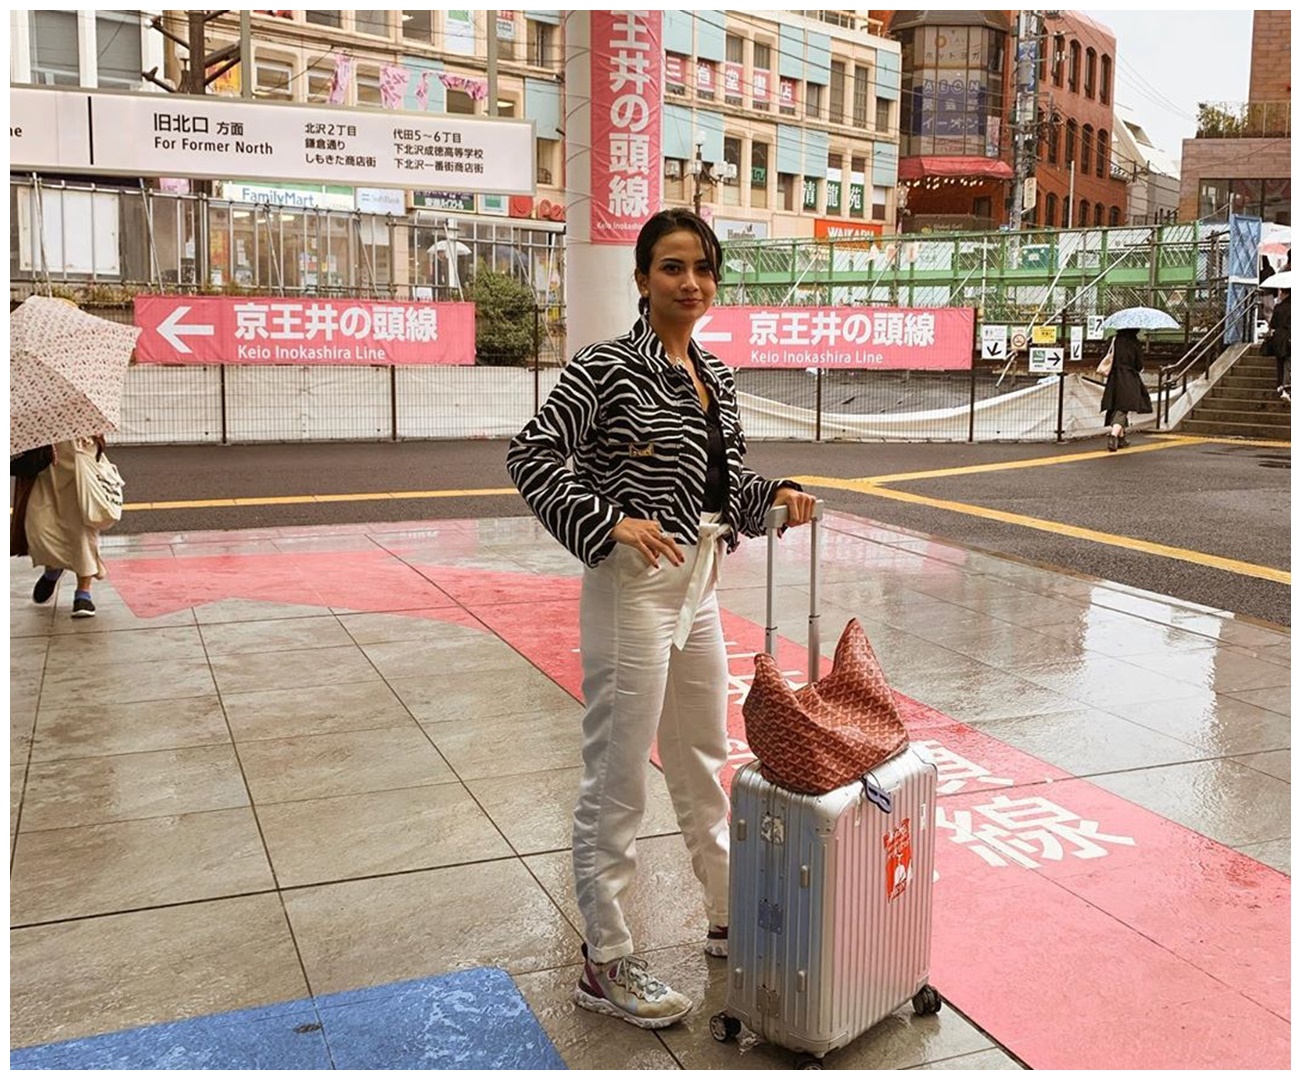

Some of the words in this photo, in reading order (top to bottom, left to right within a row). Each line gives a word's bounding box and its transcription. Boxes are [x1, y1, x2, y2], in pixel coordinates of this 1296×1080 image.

[923, 80, 980, 93] AEON
[153, 112, 209, 134] 旧北口
[216, 121, 244, 136] 方面
[305, 122, 357, 137] 北沢2丁目
[154, 136, 177, 151] For
[182, 138, 230, 153] Former
[235, 141, 274, 155] North
[304, 138, 346, 151] 鎌倉通り
[305, 153, 377, 168] しもきた商店街
[394, 158, 484, 174] 下北沢一番街商店街
[242, 187, 315, 207] FamilyMart
[233, 302, 439, 342] 京王井の頭線
[749, 310, 935, 348] 京王井の頭線
[238, 345, 271, 360] Keio
[275, 344, 351, 360] Inokashira
[355, 345, 386, 360] Line
[751, 351, 780, 364] Keio
[783, 351, 852, 364] Inokashira
[855, 351, 883, 364] Line
